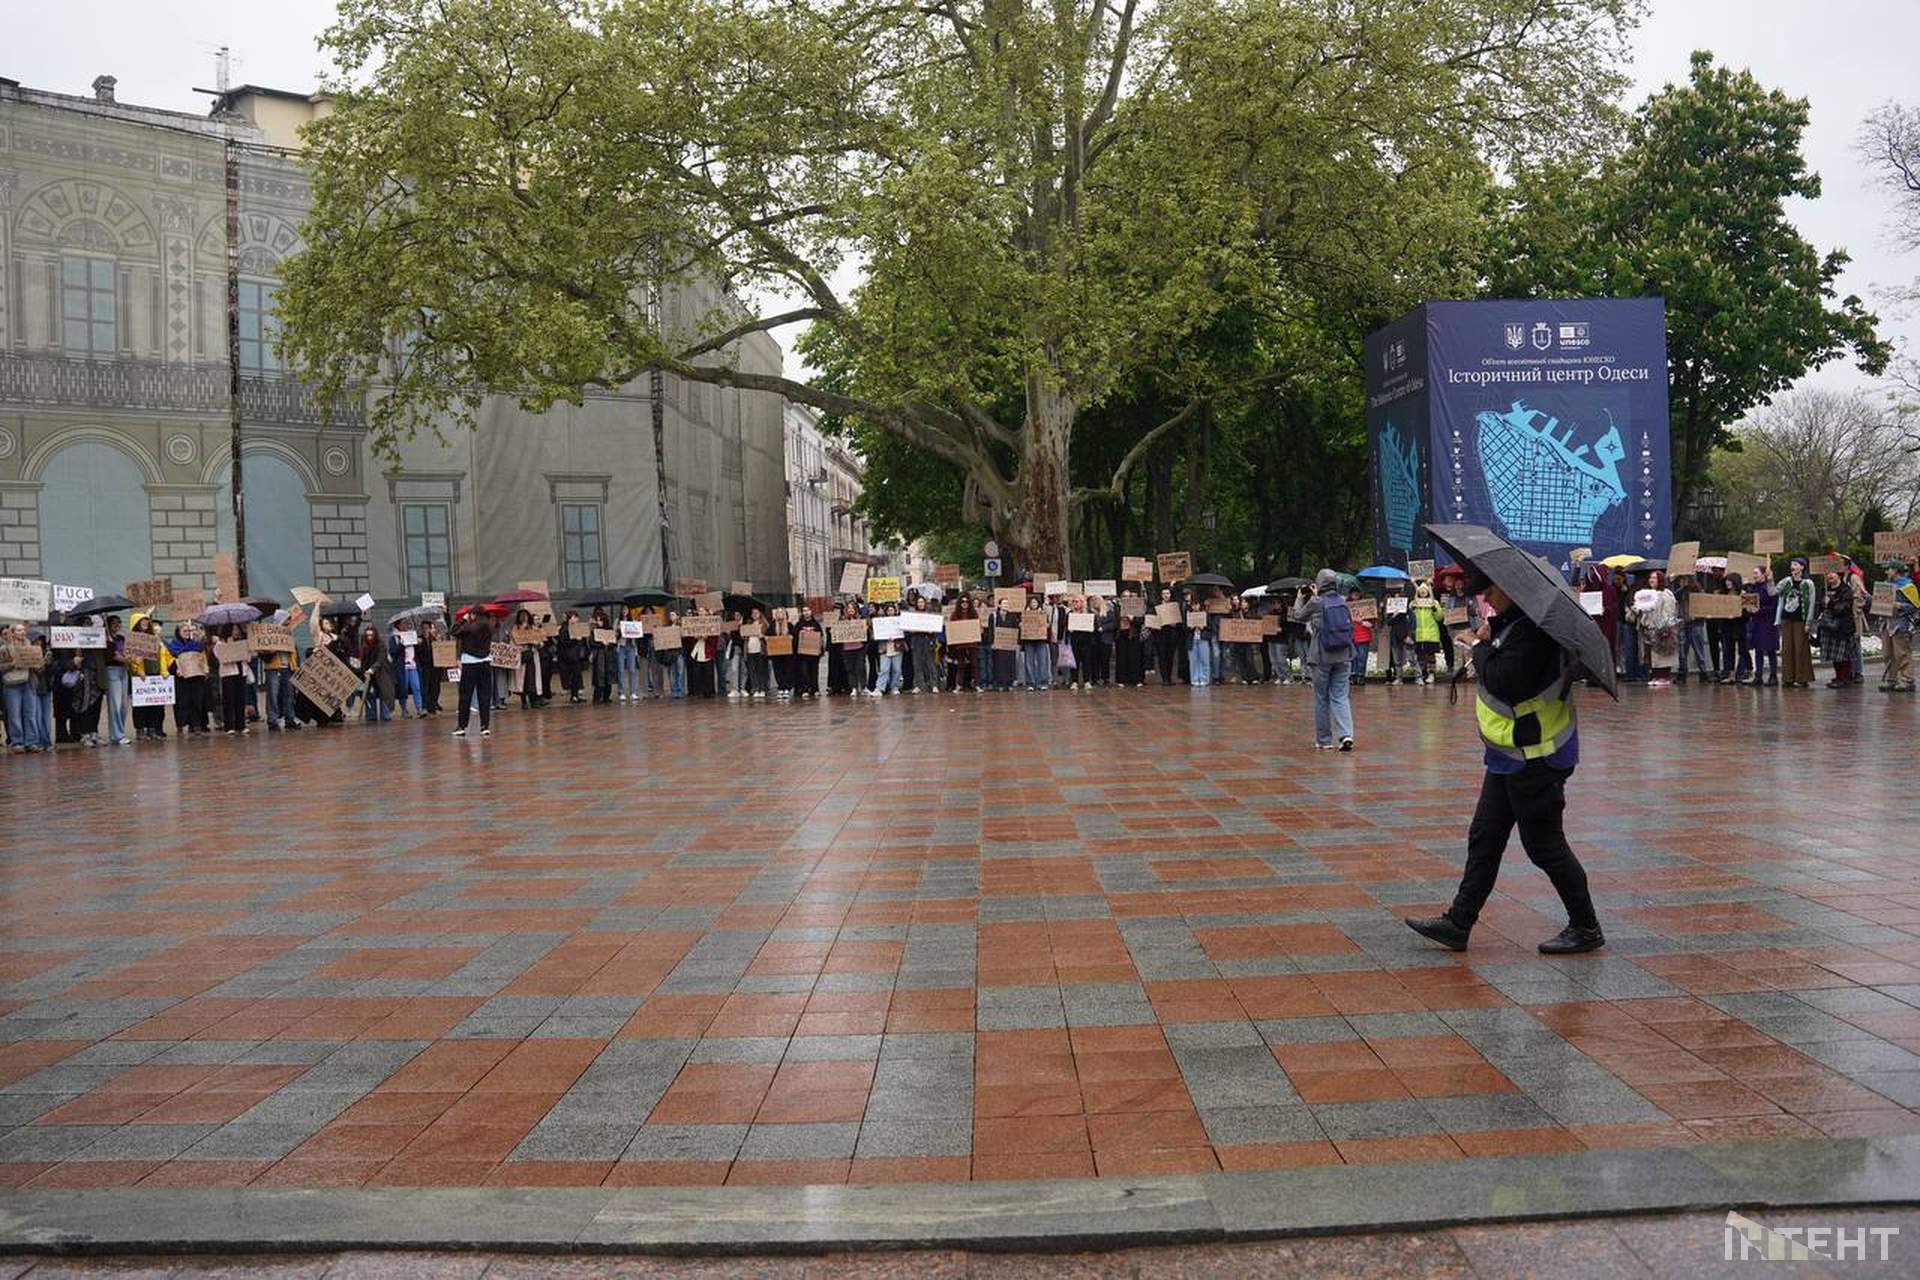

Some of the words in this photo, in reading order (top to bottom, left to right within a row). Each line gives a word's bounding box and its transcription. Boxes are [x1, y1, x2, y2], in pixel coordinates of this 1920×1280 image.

[1448, 367, 1542, 386] Історичний
[1546, 369, 1594, 385] центр
[1597, 365, 1650, 381] Одеси
